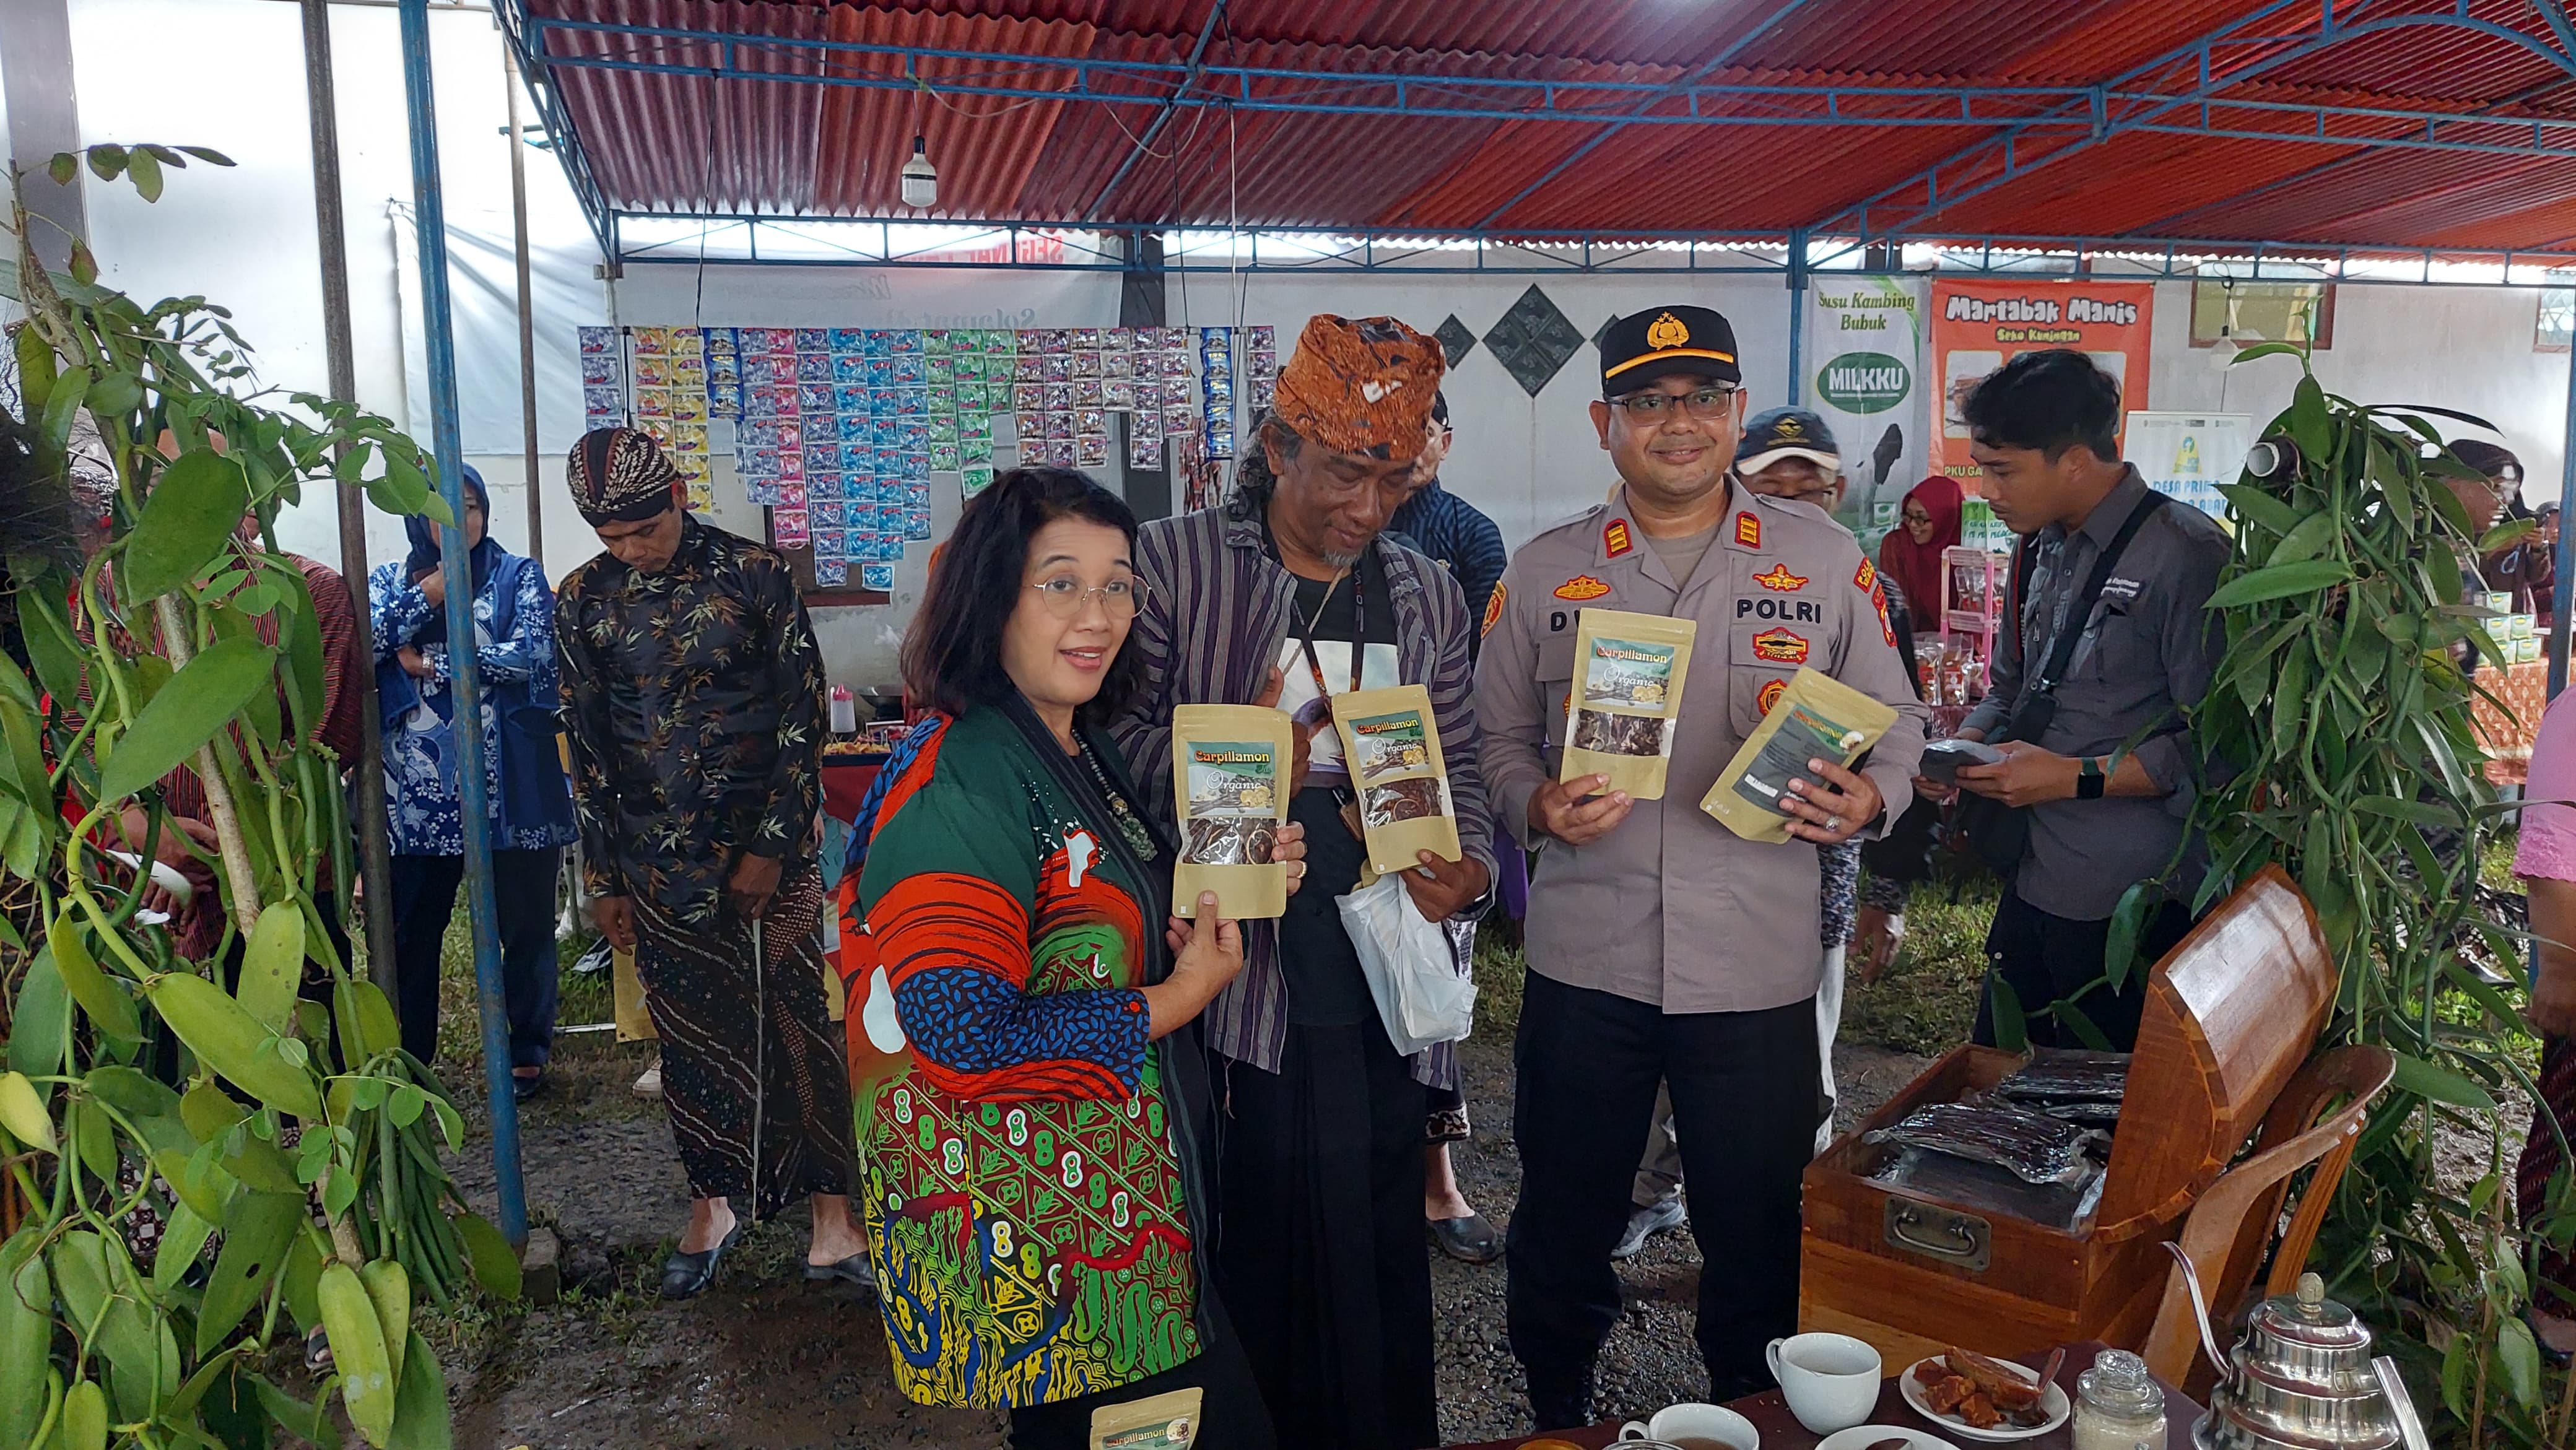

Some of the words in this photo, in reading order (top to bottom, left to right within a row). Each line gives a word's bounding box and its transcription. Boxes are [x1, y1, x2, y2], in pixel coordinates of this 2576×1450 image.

[1818, 292, 1847, 308] Susu
[1852, 292, 1915, 311] Kambing
[1945, 295, 2061, 324] Martabak
[2066, 297, 2138, 326] Manis
[1840, 314, 1886, 330] Bubuk
[1829, 367, 1903, 391] MILKKU
[1944, 466, 1965, 477] PKU
[1967, 465, 1983, 476] GA
[1737, 599, 1821, 624] POLRI
[1596, 646, 1668, 664] Carpillamon
[1356, 718, 1419, 735] Carpillamon
[1372, 737, 1419, 755] Organic
[1194, 749, 1270, 765] Carpillamon
[1206, 770, 1261, 792] Organic
